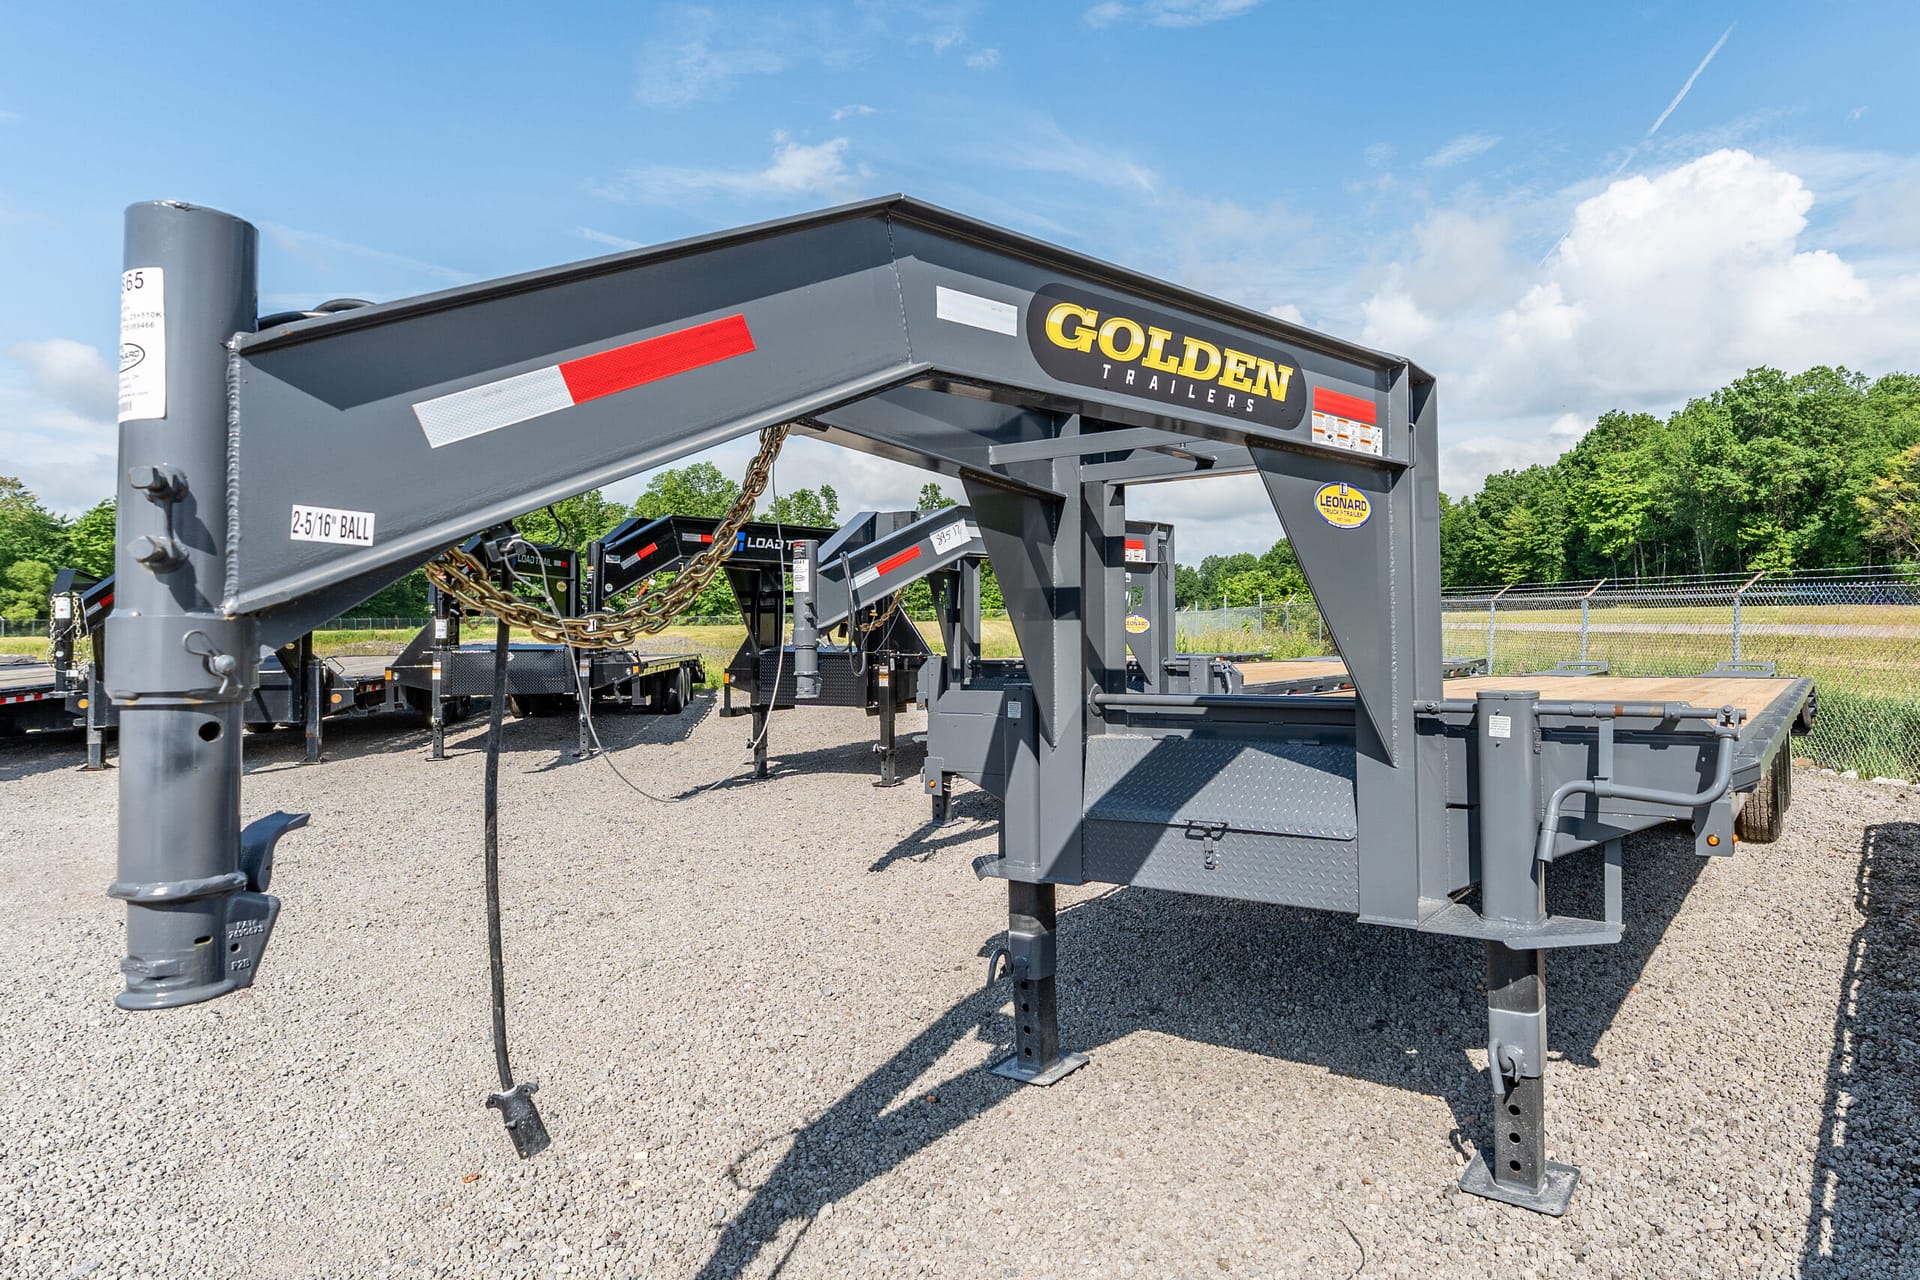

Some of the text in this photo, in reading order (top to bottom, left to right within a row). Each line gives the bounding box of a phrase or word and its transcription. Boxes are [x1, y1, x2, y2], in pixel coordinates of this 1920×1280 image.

[1045, 302, 1294, 402] GOLDEN
[1102, 363, 1255, 412] TRAILERS
[1320, 494, 1367, 512] LEONARD
[292, 510, 369, 541] 2-5/16" BALL
[747, 536, 784, 550] LOAD
[517, 554, 535, 564] LOAD
